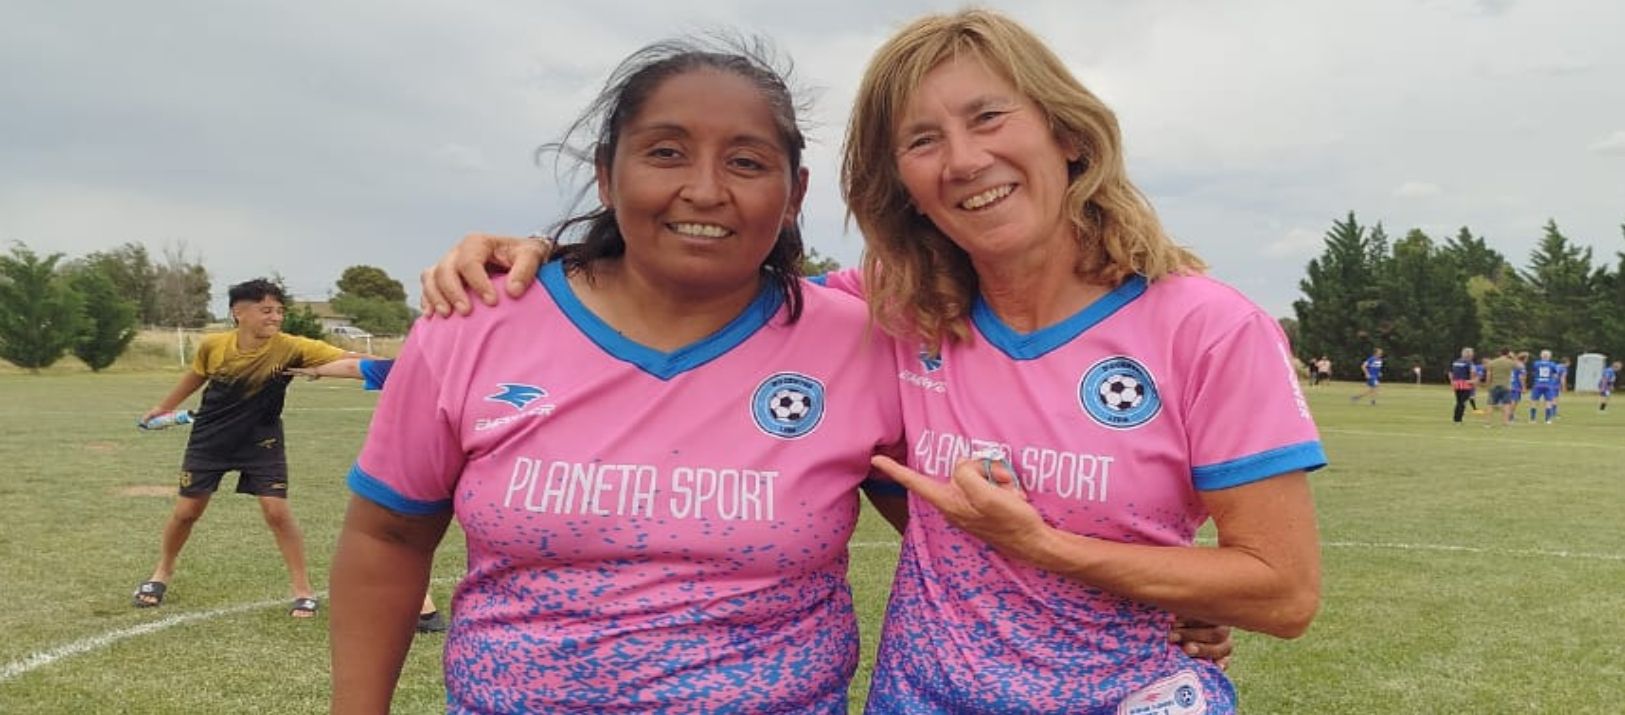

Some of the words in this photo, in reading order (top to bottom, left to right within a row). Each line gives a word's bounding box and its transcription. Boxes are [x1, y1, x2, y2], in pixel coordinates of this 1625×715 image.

[504, 456, 656, 518] PLANETA
[669, 467, 780, 521] SPORT
[1021, 446, 1115, 502] SPORT
